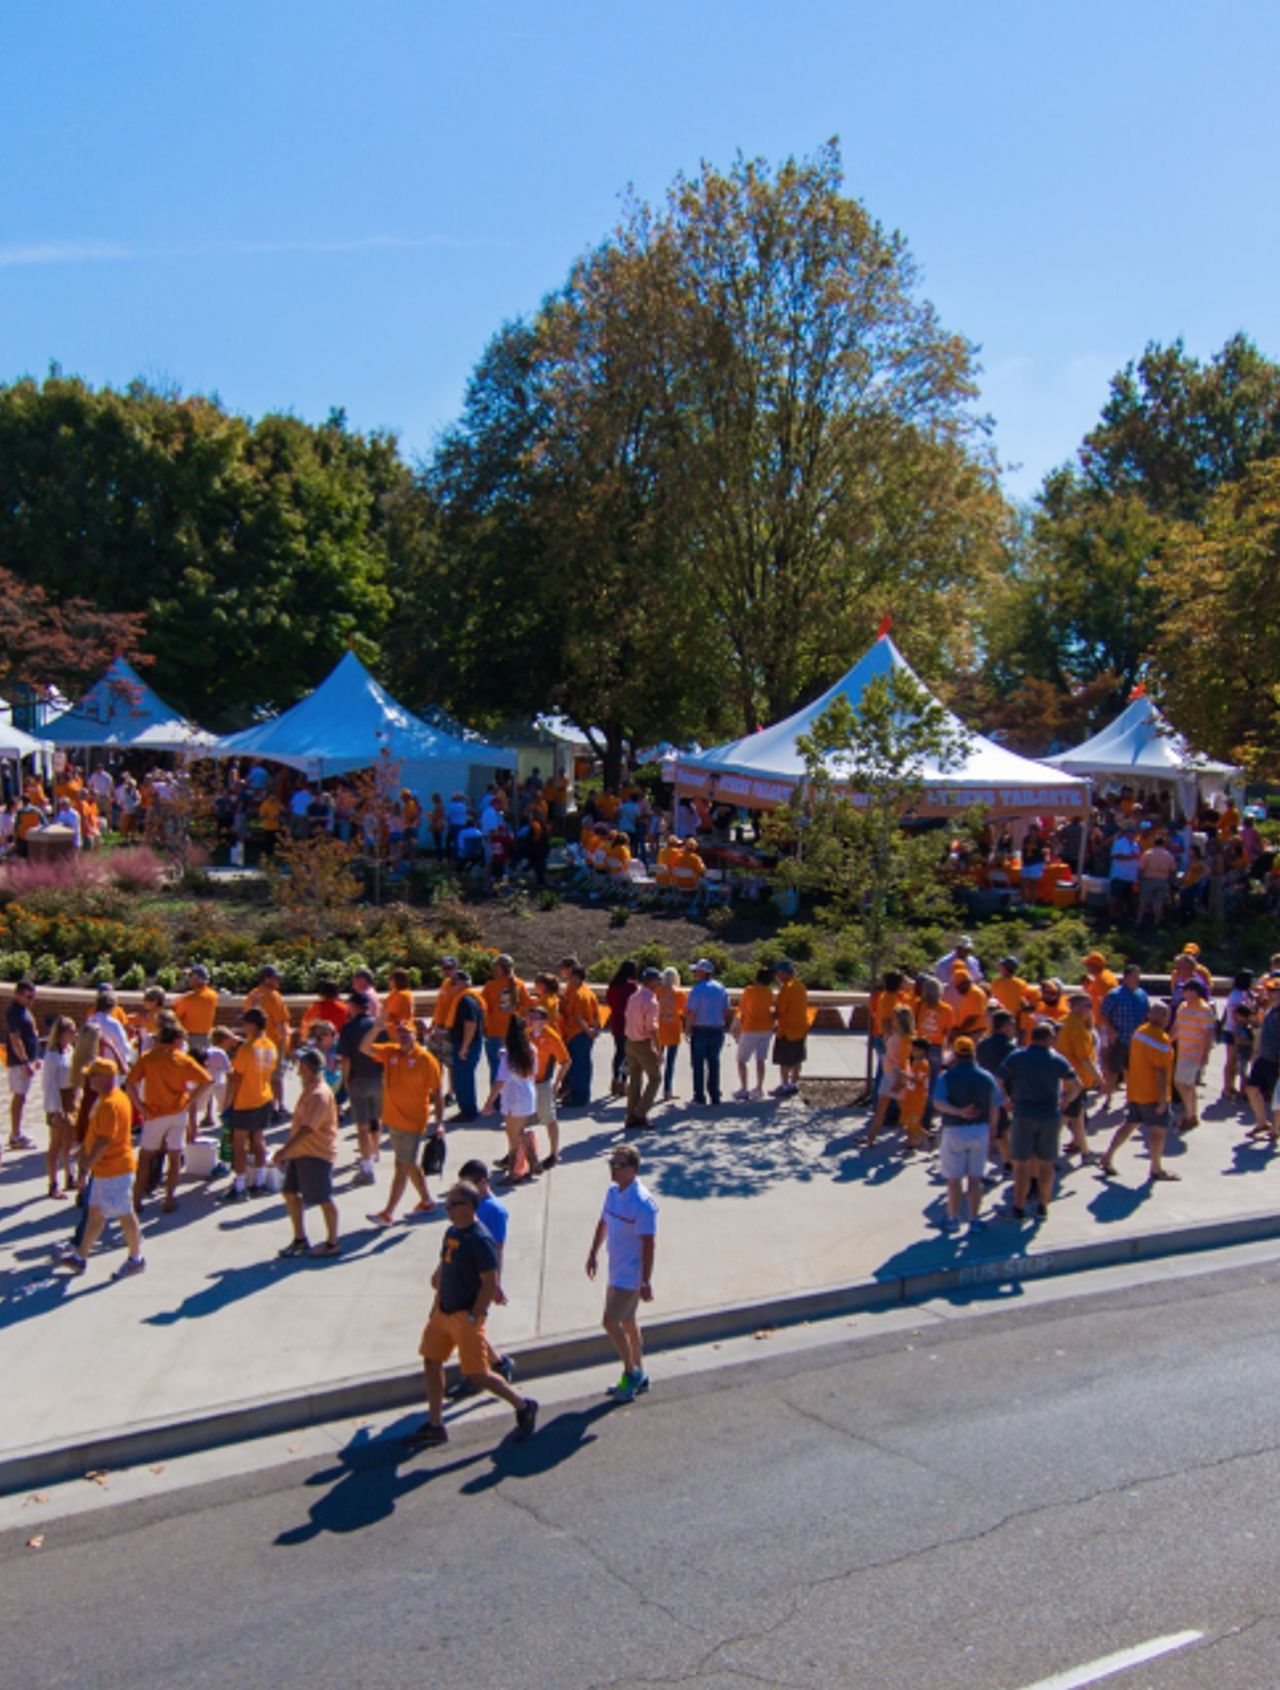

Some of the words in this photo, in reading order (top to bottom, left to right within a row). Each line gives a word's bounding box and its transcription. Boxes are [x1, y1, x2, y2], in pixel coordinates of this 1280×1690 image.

[1000, 789, 1082, 805] TAILGATE
[445, 1238, 460, 1264] T
[960, 1264, 998, 1284] BUS
[1004, 1256, 1055, 1277] STOP
